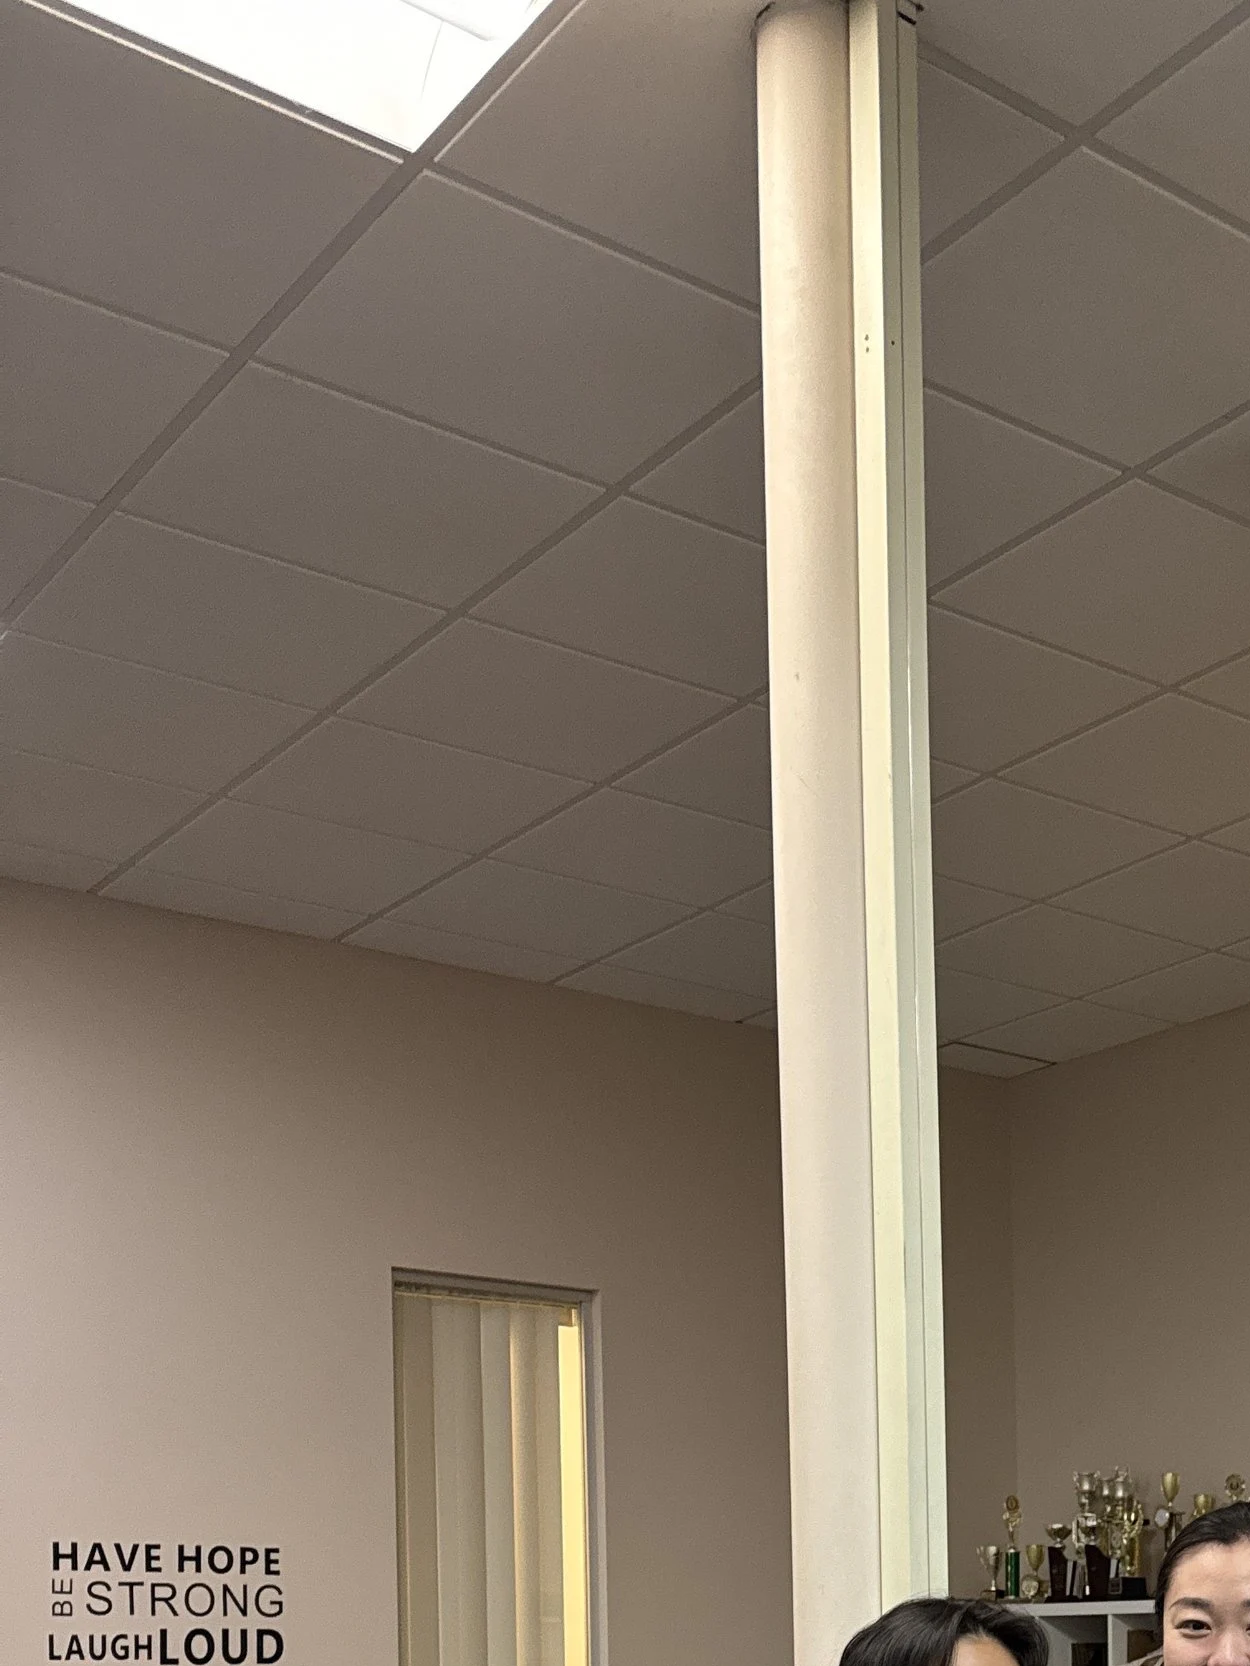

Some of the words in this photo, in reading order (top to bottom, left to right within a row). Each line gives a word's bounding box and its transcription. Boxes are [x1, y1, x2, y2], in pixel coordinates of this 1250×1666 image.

[52, 1541, 162, 1573] HAVE
[177, 1544, 281, 1576] HOPE
[52, 1578, 73, 1617] BE
[85, 1580, 284, 1618] STRONG
[48, 1633, 153, 1661] LAUGH
[159, 1627, 284, 1666] LOUD
